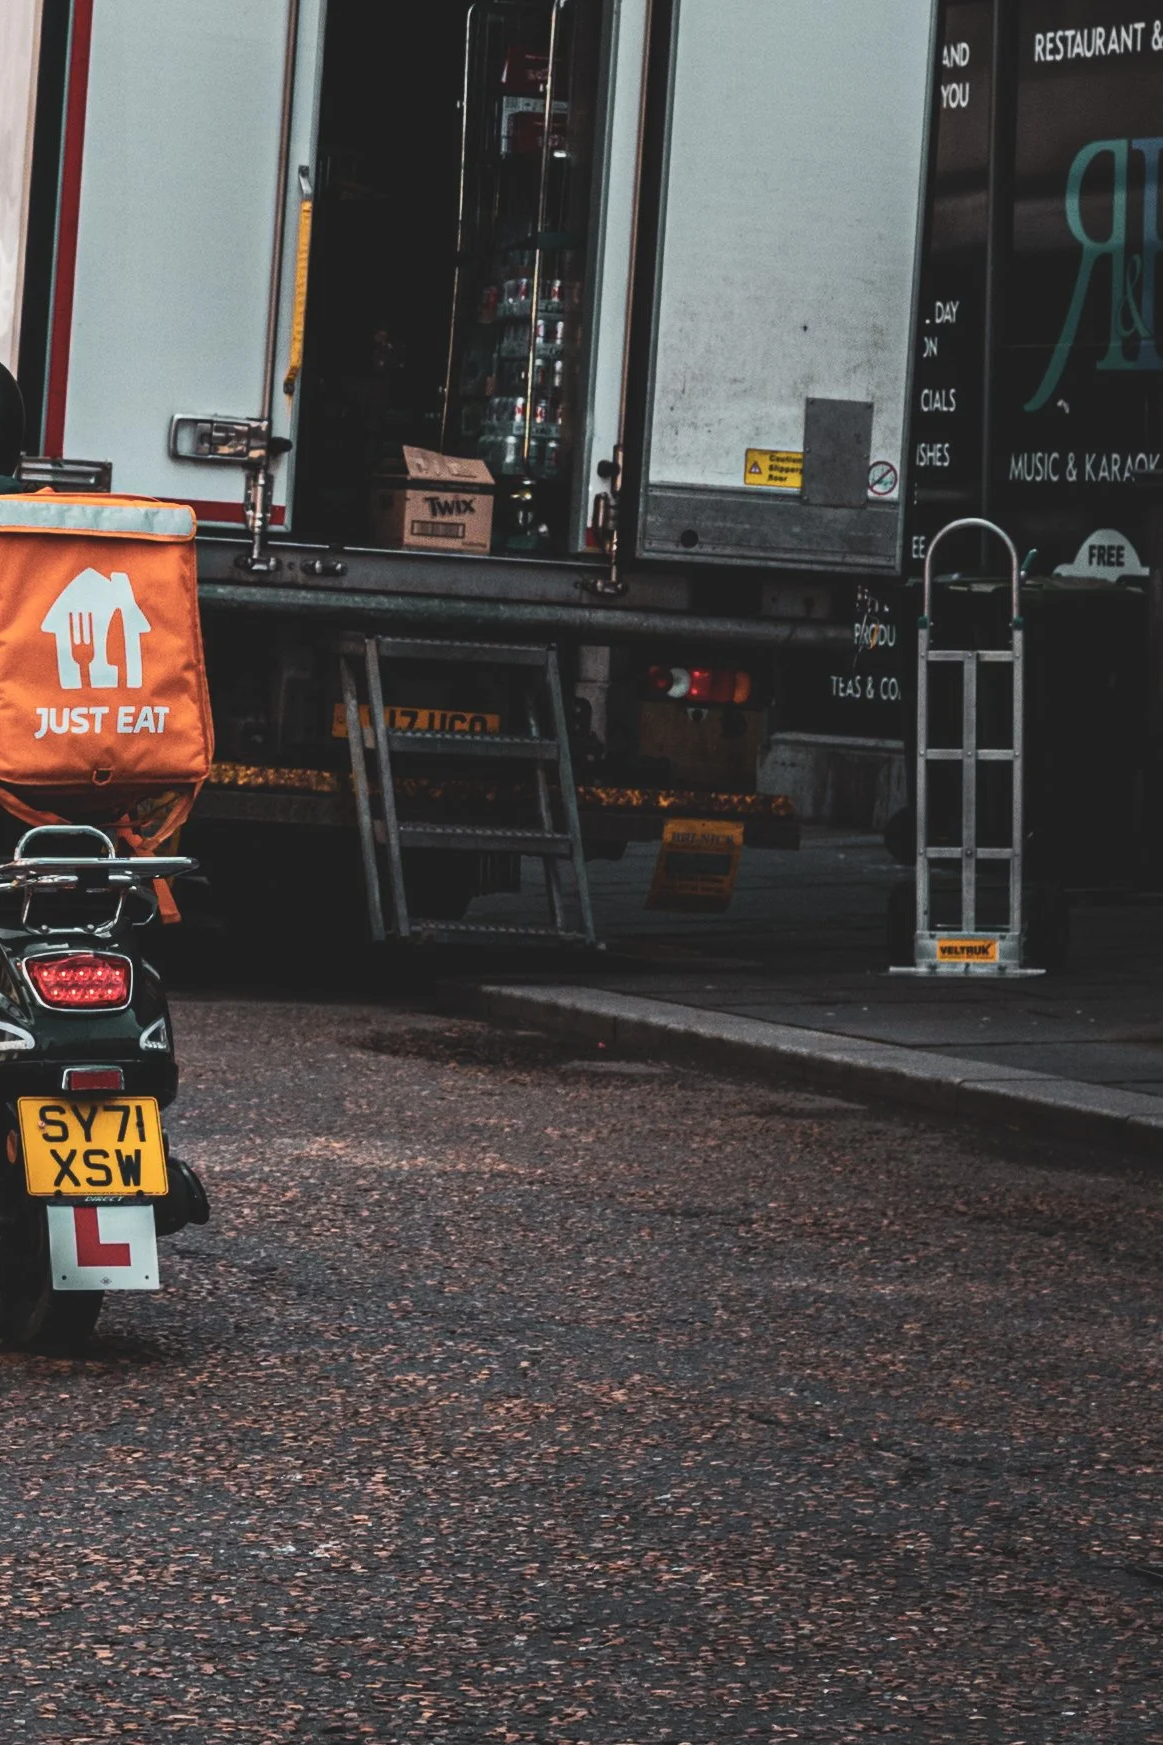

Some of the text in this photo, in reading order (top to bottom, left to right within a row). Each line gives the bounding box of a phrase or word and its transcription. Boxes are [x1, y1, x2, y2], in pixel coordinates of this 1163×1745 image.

[1035, 22, 1145, 62] RESTAURANT
[941, 82, 969, 108] YOU
[935, 300, 960, 324] DAY
[1009, 452, 1060, 482] MUSIC
[1065, 452, 1078, 482] &
[1088, 544, 1125, 567] FREE
[830, 675, 901, 701] TEAS & CO
[34, 706, 170, 739] JUST EAT
[39, 1105, 146, 1142] SY71
[50, 1149, 141, 1187] XSW
[73, 1206, 131, 1267] L
